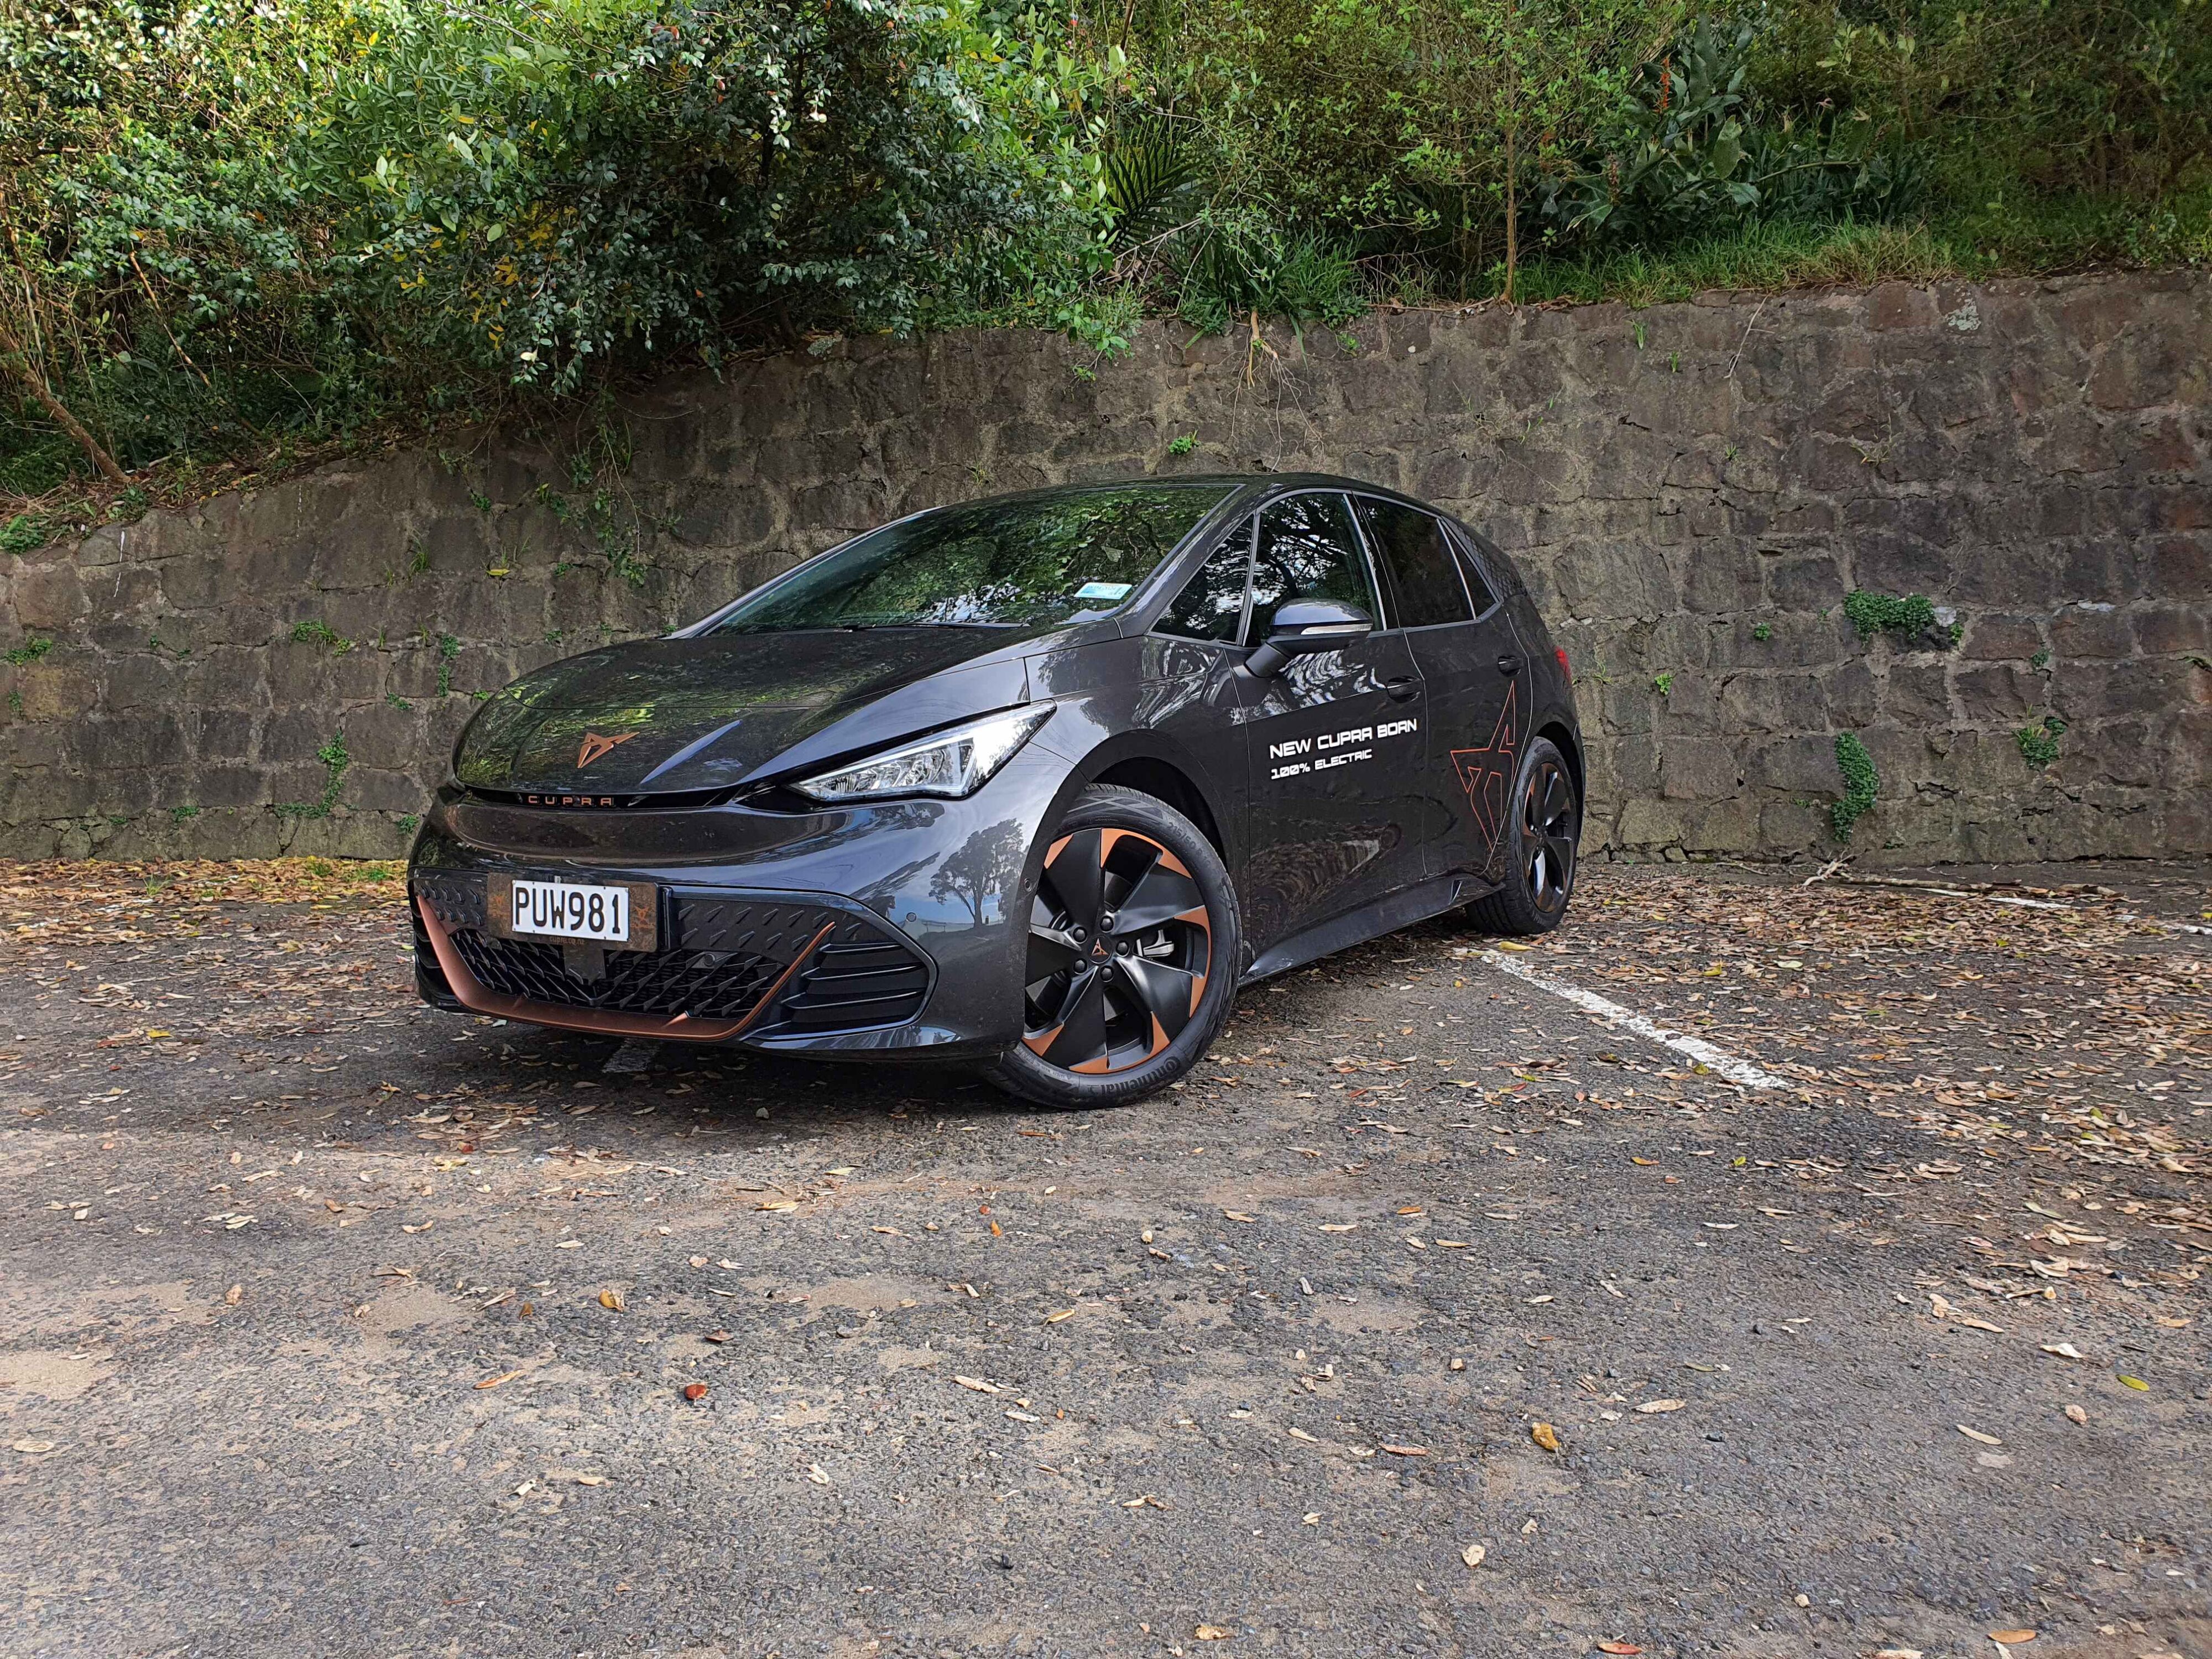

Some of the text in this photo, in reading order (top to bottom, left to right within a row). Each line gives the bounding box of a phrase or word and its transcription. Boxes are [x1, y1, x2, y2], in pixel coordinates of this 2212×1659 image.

[1270, 718, 1417, 759] NEW CUPRA BORN
[1271, 749, 1373, 780] 100% ELECTRIC
[528, 796, 612, 806] CUPRA
[515, 887, 620, 934] PUW981
[1100, 1056, 1181, 1094] Continental
